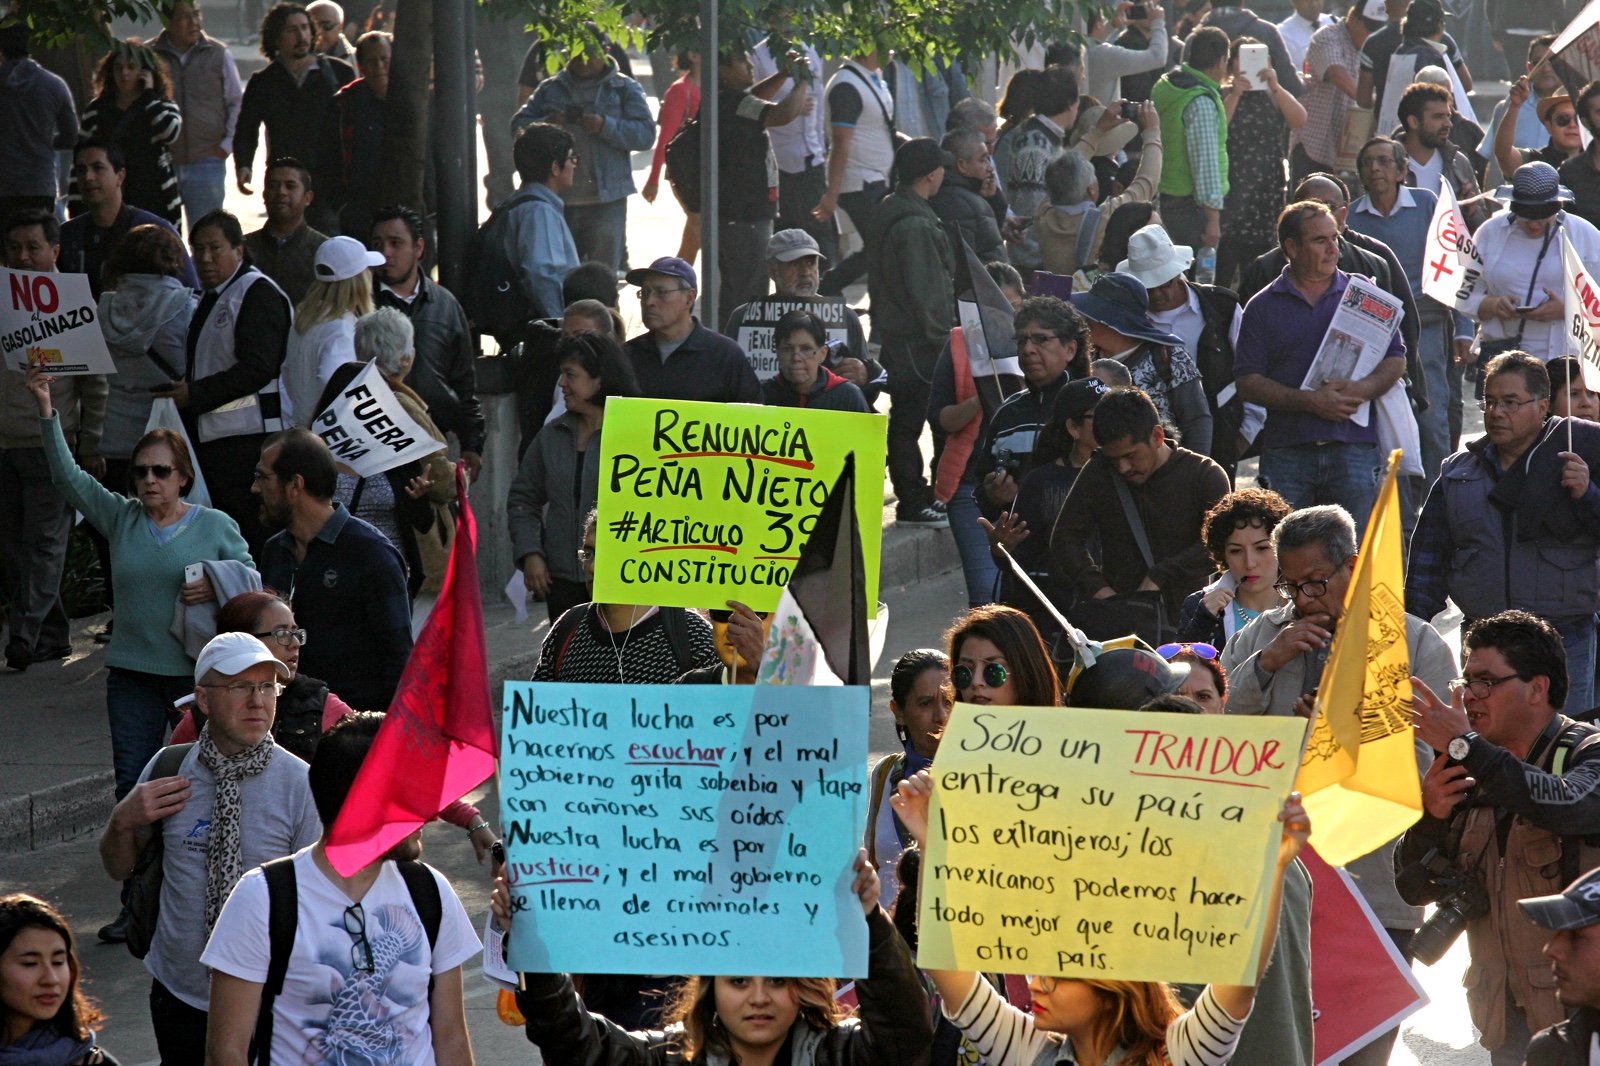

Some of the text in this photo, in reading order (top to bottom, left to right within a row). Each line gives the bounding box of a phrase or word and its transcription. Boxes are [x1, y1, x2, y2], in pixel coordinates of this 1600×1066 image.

[9, 273, 59, 314] NO
[31, 306, 41, 322] al
[742, 302, 761, 324] ¡LOS
[2, 306, 95, 353] GASOLINAZO
[316, 408, 370, 461] PEÑA
[344, 384, 416, 452] FUERA
[653, 410, 813, 462] RENUNCIA
[610, 454, 829, 508] PEÑA NIETO
[620, 556, 790, 587] CONSTITUCIO
[511, 688, 790, 736] Nuestra lucha es por
[508, 734, 615, 762] hacernos
[765, 740, 782, 762] el
[798, 738, 838, 762] mal
[960, 714, 1286, 777] Sólo un TRAIDOR
[509, 766, 862, 803] gobierno grita soberbia y tapa
[942, 763, 1244, 823] entrega su país a
[507, 795, 791, 826] con cañones sus oídos.
[507, 819, 808, 863] Nuestra lucha es por la
[940, 807, 1174, 861] los extranjeros; los
[618, 866, 628, 887] y
[641, 863, 658, 883] el
[674, 862, 714, 885] mal
[730, 864, 822, 894] gobierno
[934, 862, 1248, 907] mexicanos podemos hacer
[510, 890, 819, 926] se llena de criminales y
[929, 896, 1241, 956] todo mejor que cualquier
[614, 926, 741, 947] asesinos.
[976, 936, 1114, 972] otro país.
